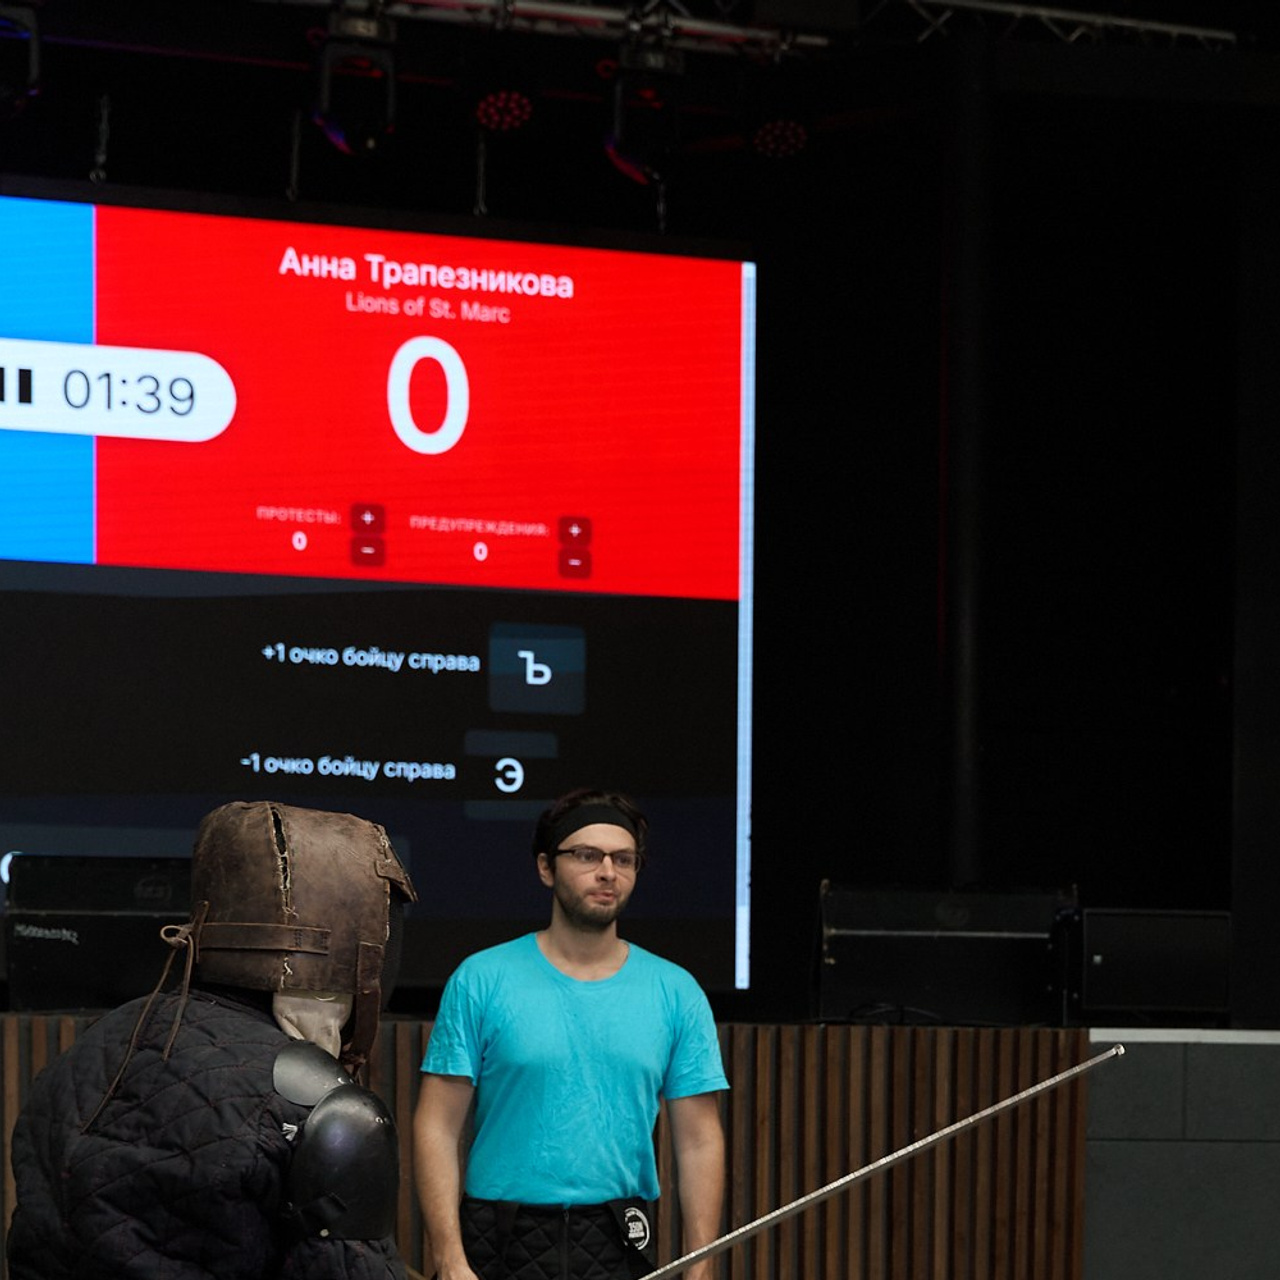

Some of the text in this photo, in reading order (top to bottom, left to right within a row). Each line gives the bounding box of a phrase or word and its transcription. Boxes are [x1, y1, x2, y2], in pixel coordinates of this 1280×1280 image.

[278, 246, 574, 298] Анна Трапезникова
[345, 291, 511, 323] Lions of St. Marc
[63, 369, 195, 416] 01:39
[387, 335, 470, 455] 0
[291, 531, 308, 551] 0
[473, 541, 489, 562] 0
[262, 642, 481, 675] +1 очко бойцу справа
[240, 752, 456, 782] -1 очко бойцу справа
